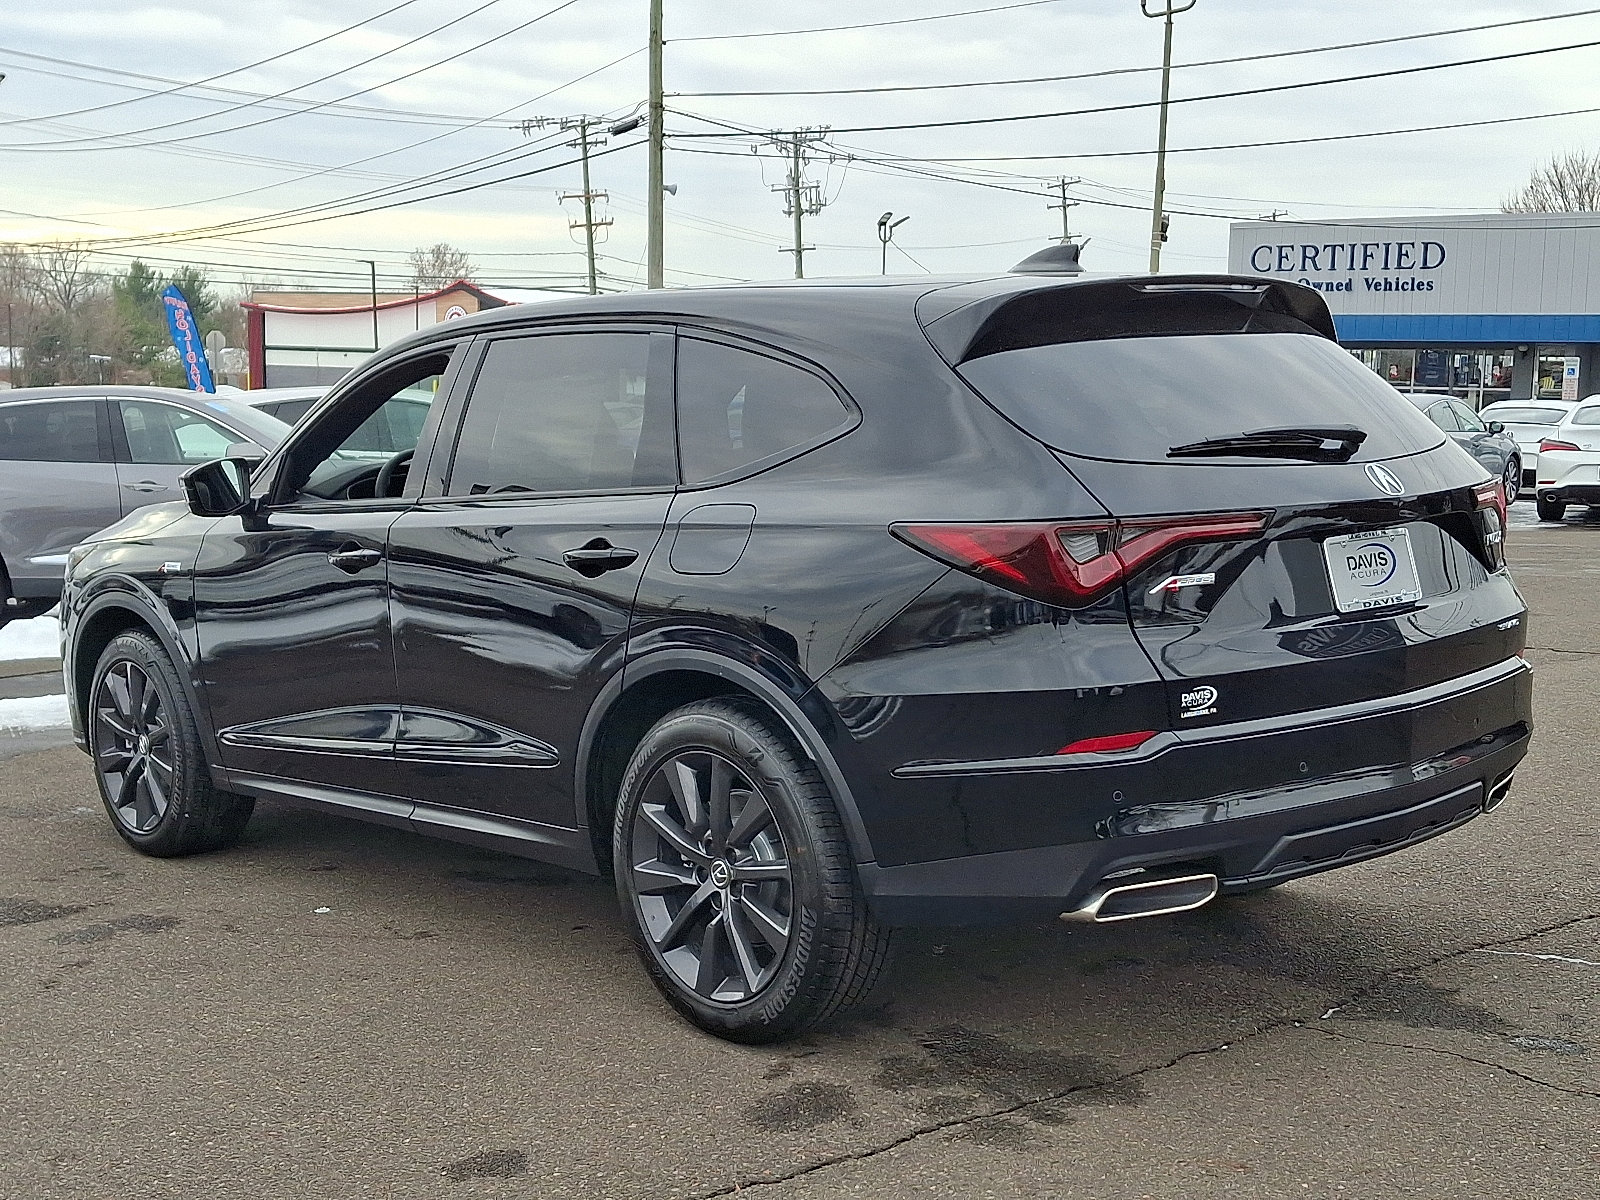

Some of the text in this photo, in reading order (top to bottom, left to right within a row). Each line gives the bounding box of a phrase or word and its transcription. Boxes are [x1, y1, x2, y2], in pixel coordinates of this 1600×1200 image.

[1250, 241, 1446, 272] CERTIFIED
[1364, 276, 1434, 292] Vehicles
[1346, 551, 1388, 571] DAVIS
[1350, 568, 1387, 580] ACURA
[1362, 596, 1403, 609] DAVIS
[1181, 689, 1211, 703] DAVIS
[1181, 698, 1209, 708] ACURA
[760, 904, 818, 1025] BRIDGESTONE
